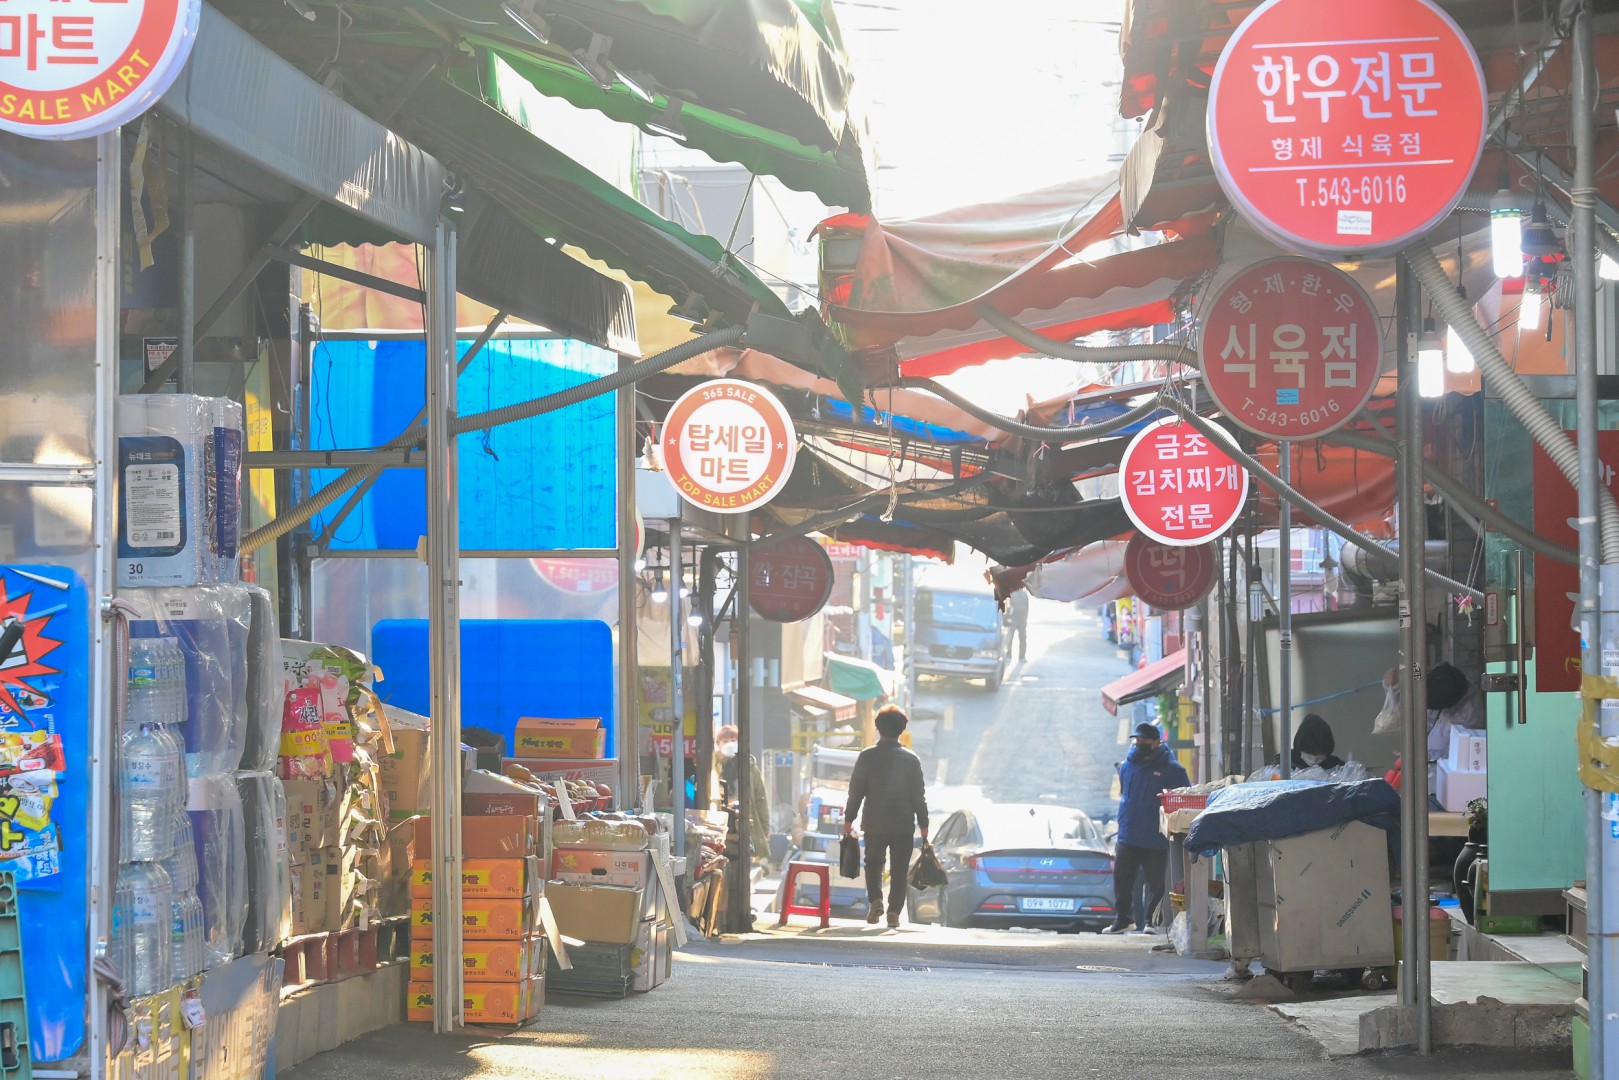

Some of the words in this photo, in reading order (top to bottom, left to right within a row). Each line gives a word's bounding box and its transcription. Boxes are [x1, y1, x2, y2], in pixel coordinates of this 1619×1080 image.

[0, 14, 98, 70] 마트
[0, 94, 71, 120] SALE
[80, 49, 150, 112] MART
[1252, 52, 1442, 123] 한우전문
[1271, 137, 1322, 161] 형제
[1341, 132, 1421, 157] 식육점
[1296, 175, 1407, 207] T.543-6016
[1220, 323, 1357, 389] 식육점
[703, 388, 723, 400] 365
[726, 388, 757, 404] SALE
[1241, 396, 1340, 427] T.543-6016
[688, 424, 766, 454] 탑세일
[700, 457, 750, 484] 마트
[1132, 464, 1238, 496] 김치찌개
[677, 474, 701, 497] TOP
[703, 493, 737, 507] SALE
[740, 474, 774, 503] MART
[1160, 503, 1213, 530] 전문
[129, 564, 144, 574] 30
[1150, 546, 1186, 591] 떡
[1336, 897, 1363, 928] DONGSUNG
